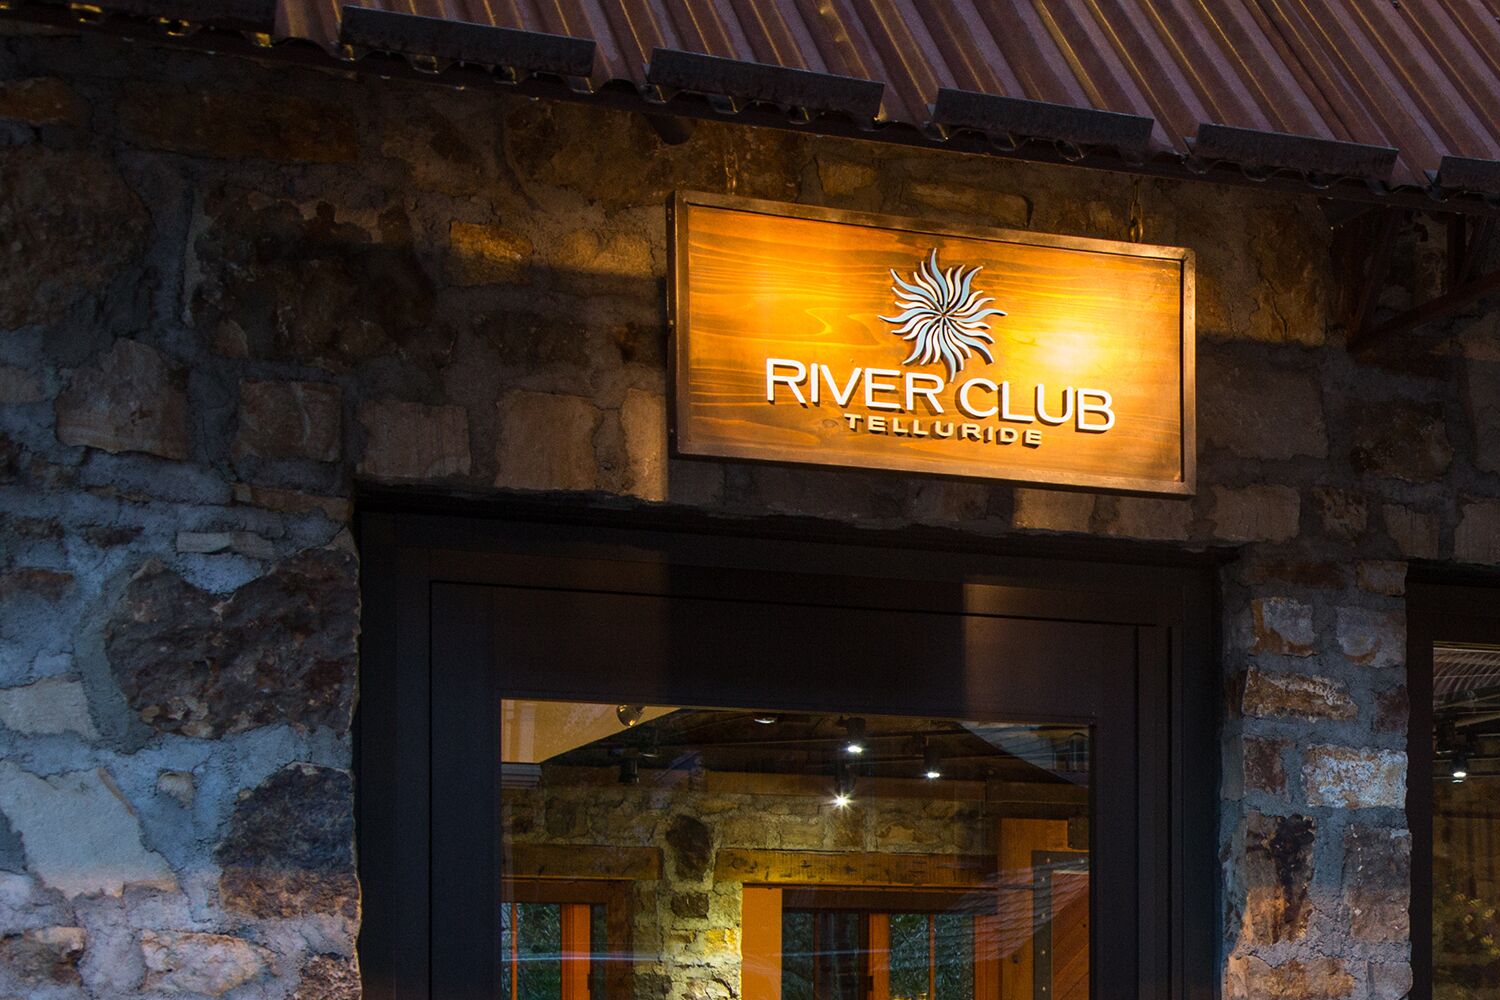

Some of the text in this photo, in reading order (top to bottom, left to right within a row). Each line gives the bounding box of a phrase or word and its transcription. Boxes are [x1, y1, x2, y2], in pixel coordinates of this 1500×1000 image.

[765, 358, 1116, 433] RIVER CLUB
[843, 413, 1043, 447] TELLURIDE
